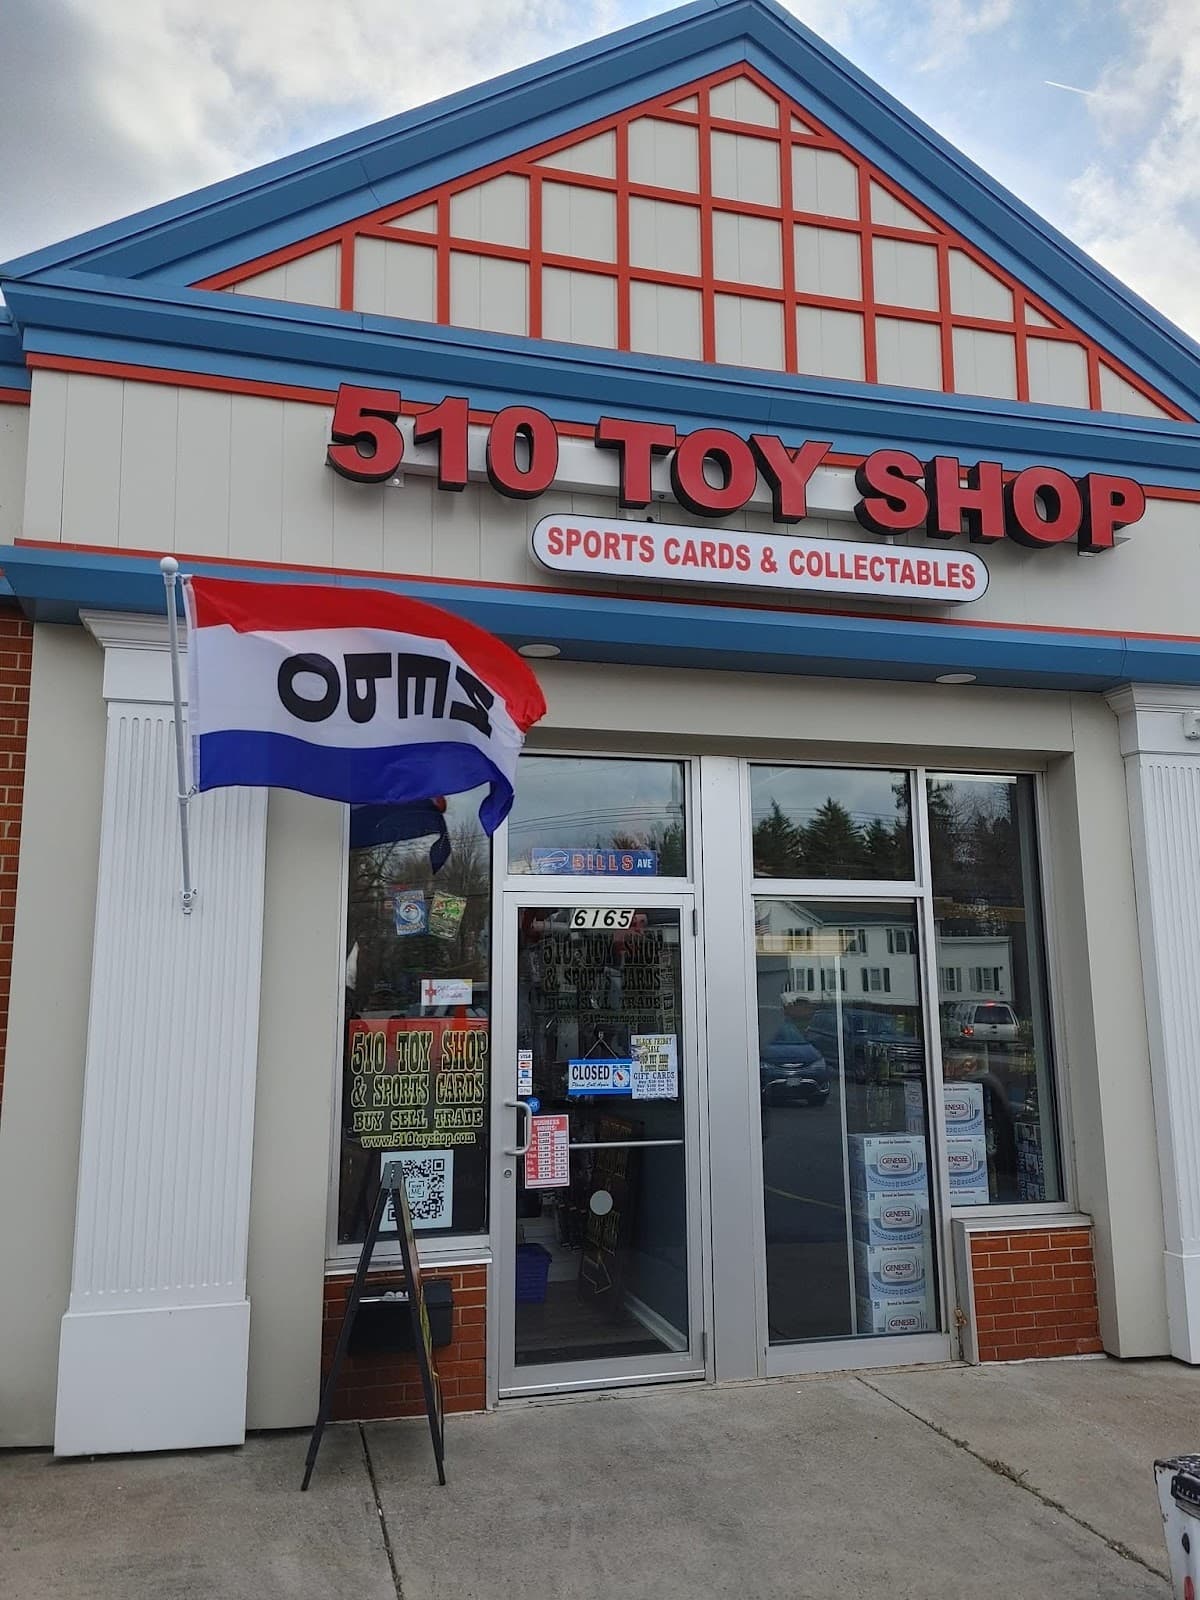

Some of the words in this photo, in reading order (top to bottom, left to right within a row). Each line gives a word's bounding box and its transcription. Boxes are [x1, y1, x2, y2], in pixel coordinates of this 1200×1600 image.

[327, 383, 559, 498] 510
[595, 416, 833, 523] TOY
[854, 449, 1146, 553] SHOP
[547, 526, 655, 563] SPORTS
[664, 538, 751, 571] CARDS
[760, 546, 778, 573] &
[788, 550, 976, 590] COLLECTABLES
[572, 853, 634, 871] BILLS
[637, 858, 653, 869] AVE
[573, 909, 632, 928] 6165
[543, 934, 573, 966] 510
[583, 934, 614, 966] TOY
[623, 930, 663, 965] SHOP
[564, 967, 611, 991] SPORTS
[351, 1031, 386, 1075] 510
[396, 1030, 433, 1074] TOY
[441, 1029, 489, 1073] SHOP
[572, 1065, 610, 1081] CLOSED
[633, 1072, 649, 1080] GIFT
[350, 1075, 367, 1108] &
[373, 1074, 430, 1107] SPORTS
[435, 1073, 485, 1105] CARDS
[944, 1103, 965, 1111] ENESEE
[353, 1110, 384, 1131] BUY
[390, 1110, 428, 1131] SELL
[434, 1108, 483, 1129] TRADE
[361, 1131, 476, 1149] www.510toyshop.com
[882, 1157, 908, 1165] GENESEE
[947, 1155, 969, 1163] ENESEE
[885, 1210, 911, 1218] GENESEE
[885, 1263, 912, 1272] GENESEE
[890, 1318, 916, 1327] GENESEE
